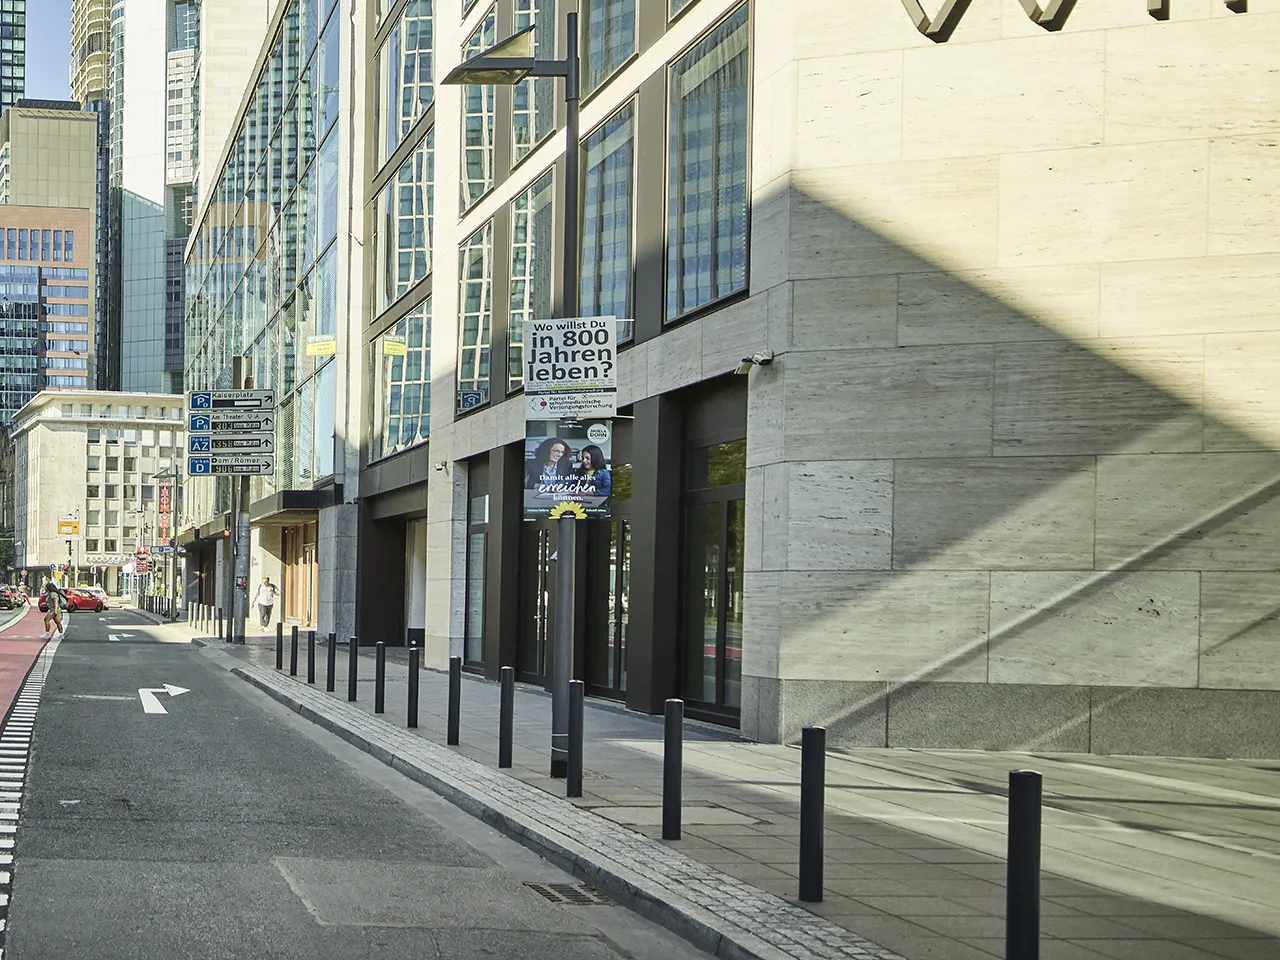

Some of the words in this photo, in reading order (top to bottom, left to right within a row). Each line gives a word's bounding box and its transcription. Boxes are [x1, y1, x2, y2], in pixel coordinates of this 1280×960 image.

[556, 321, 586, 330] willst
[532, 332, 553, 348] in
[563, 329, 609, 346] 800
[528, 347, 611, 364] Jahren
[529, 362, 613, 381] leben?
[196, 464, 204, 472] D
[539, 480, 596, 494] erreichen
